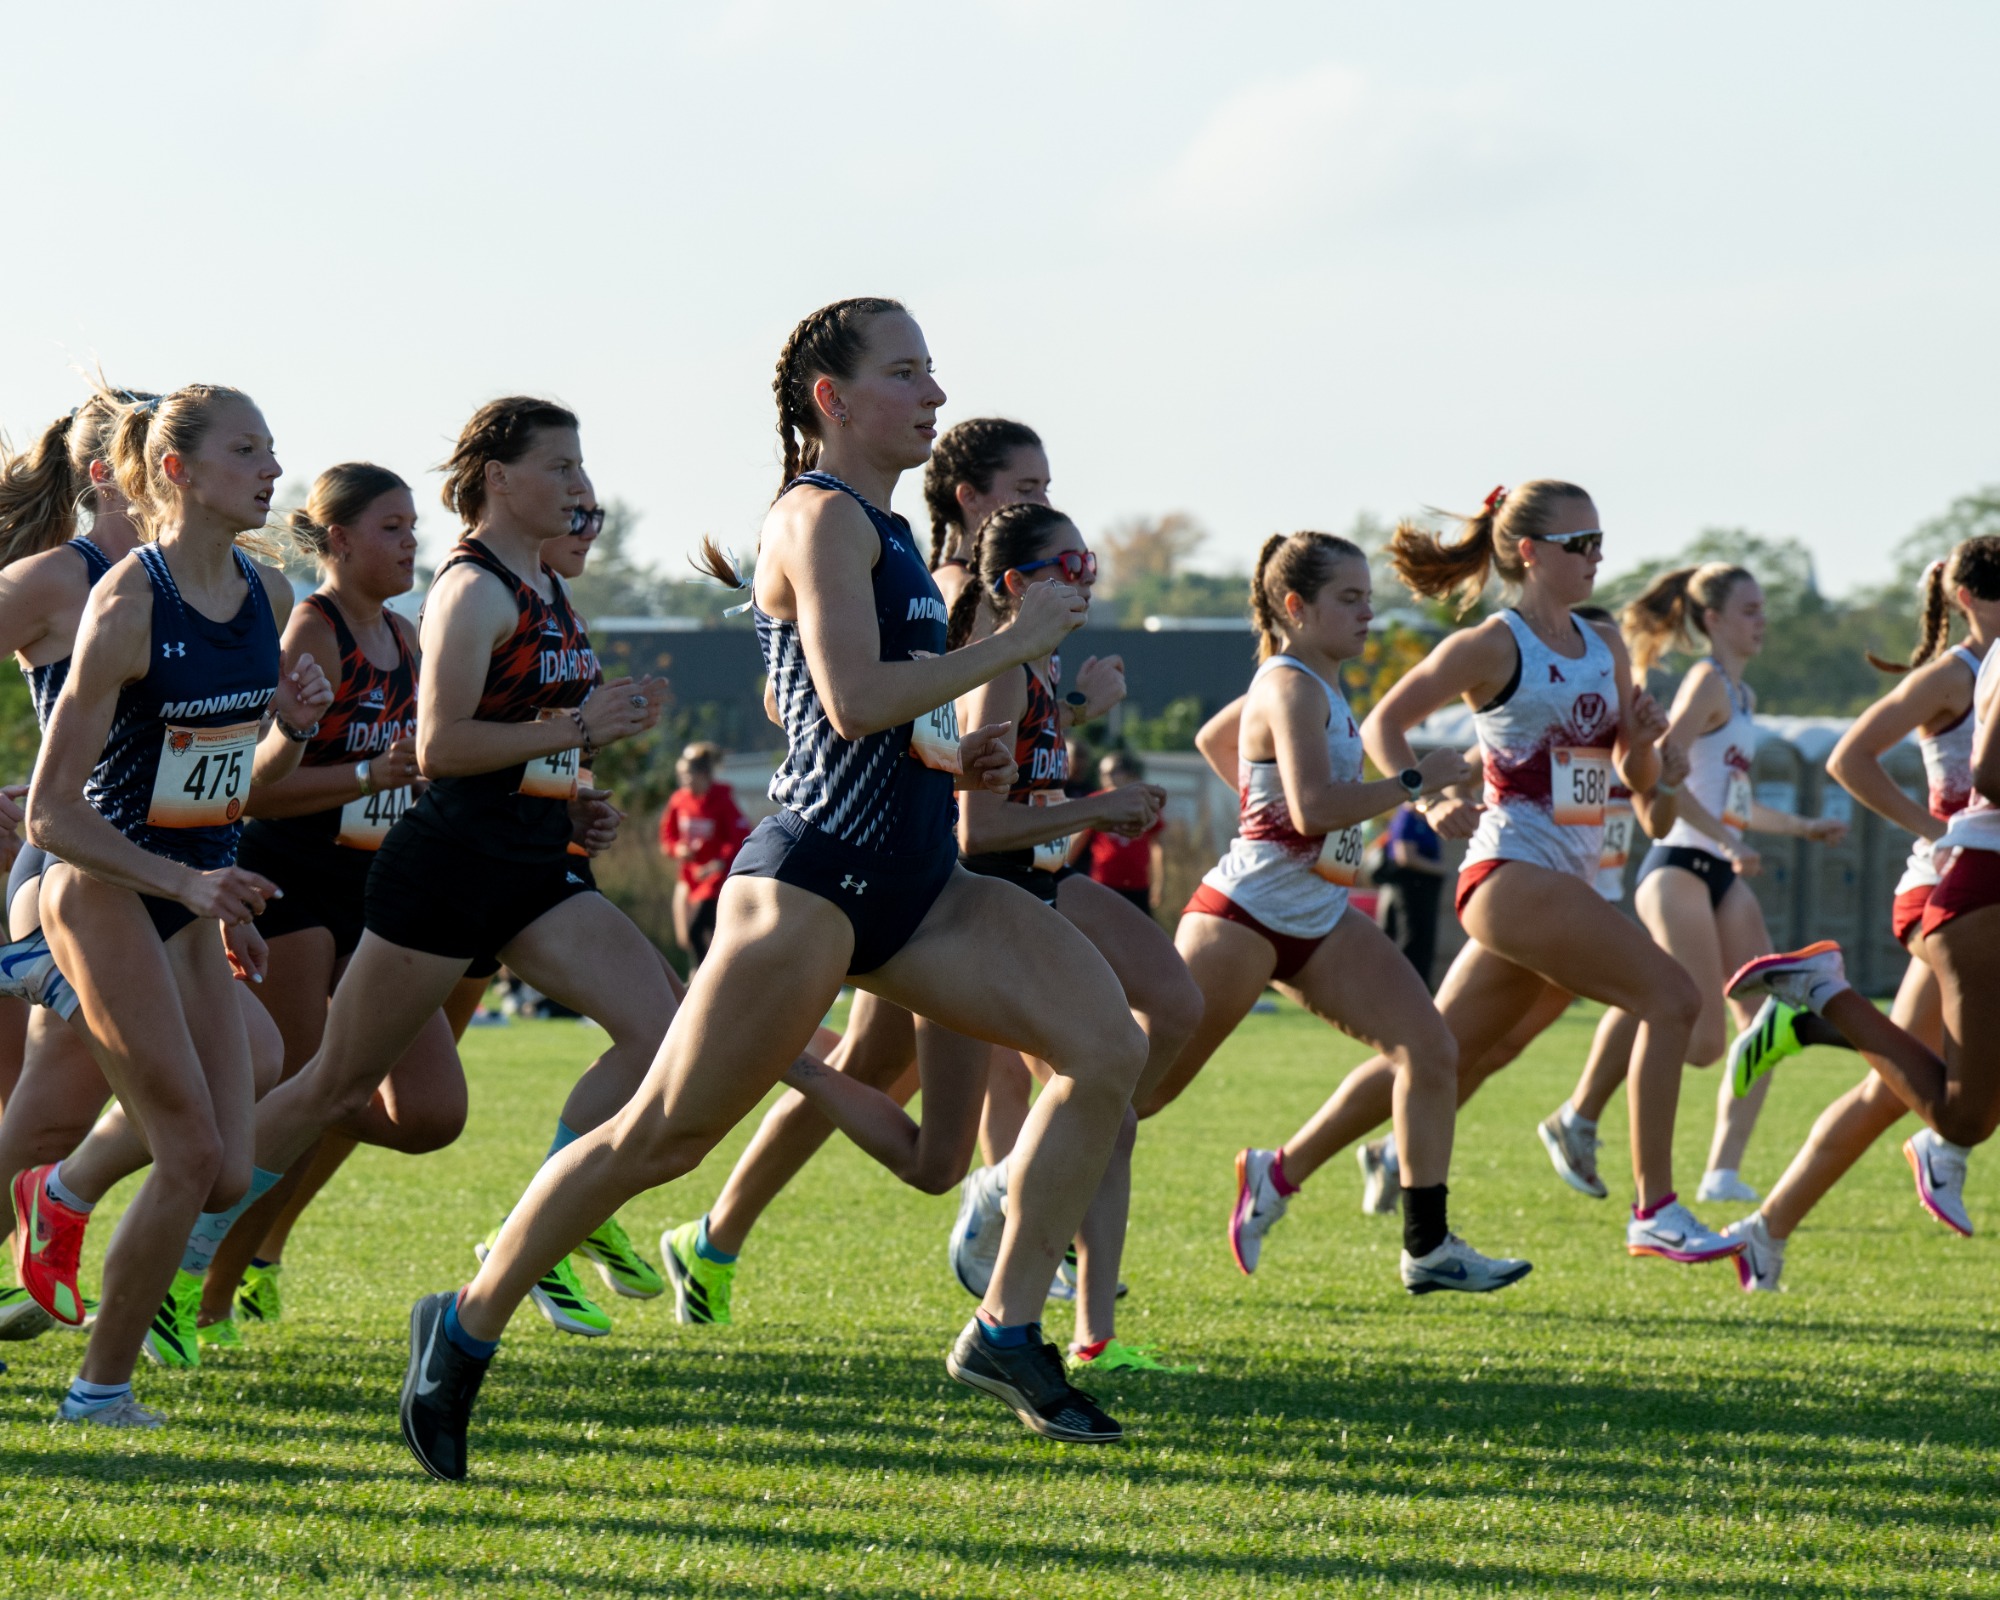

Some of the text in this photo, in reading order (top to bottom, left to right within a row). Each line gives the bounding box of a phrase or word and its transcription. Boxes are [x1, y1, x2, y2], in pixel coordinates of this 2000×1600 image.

[907, 596, 949, 626] MONMO
[540, 649, 581, 684] IDAHO
[159, 685, 278, 718] MONMOUT
[183, 750, 243, 800] 475
